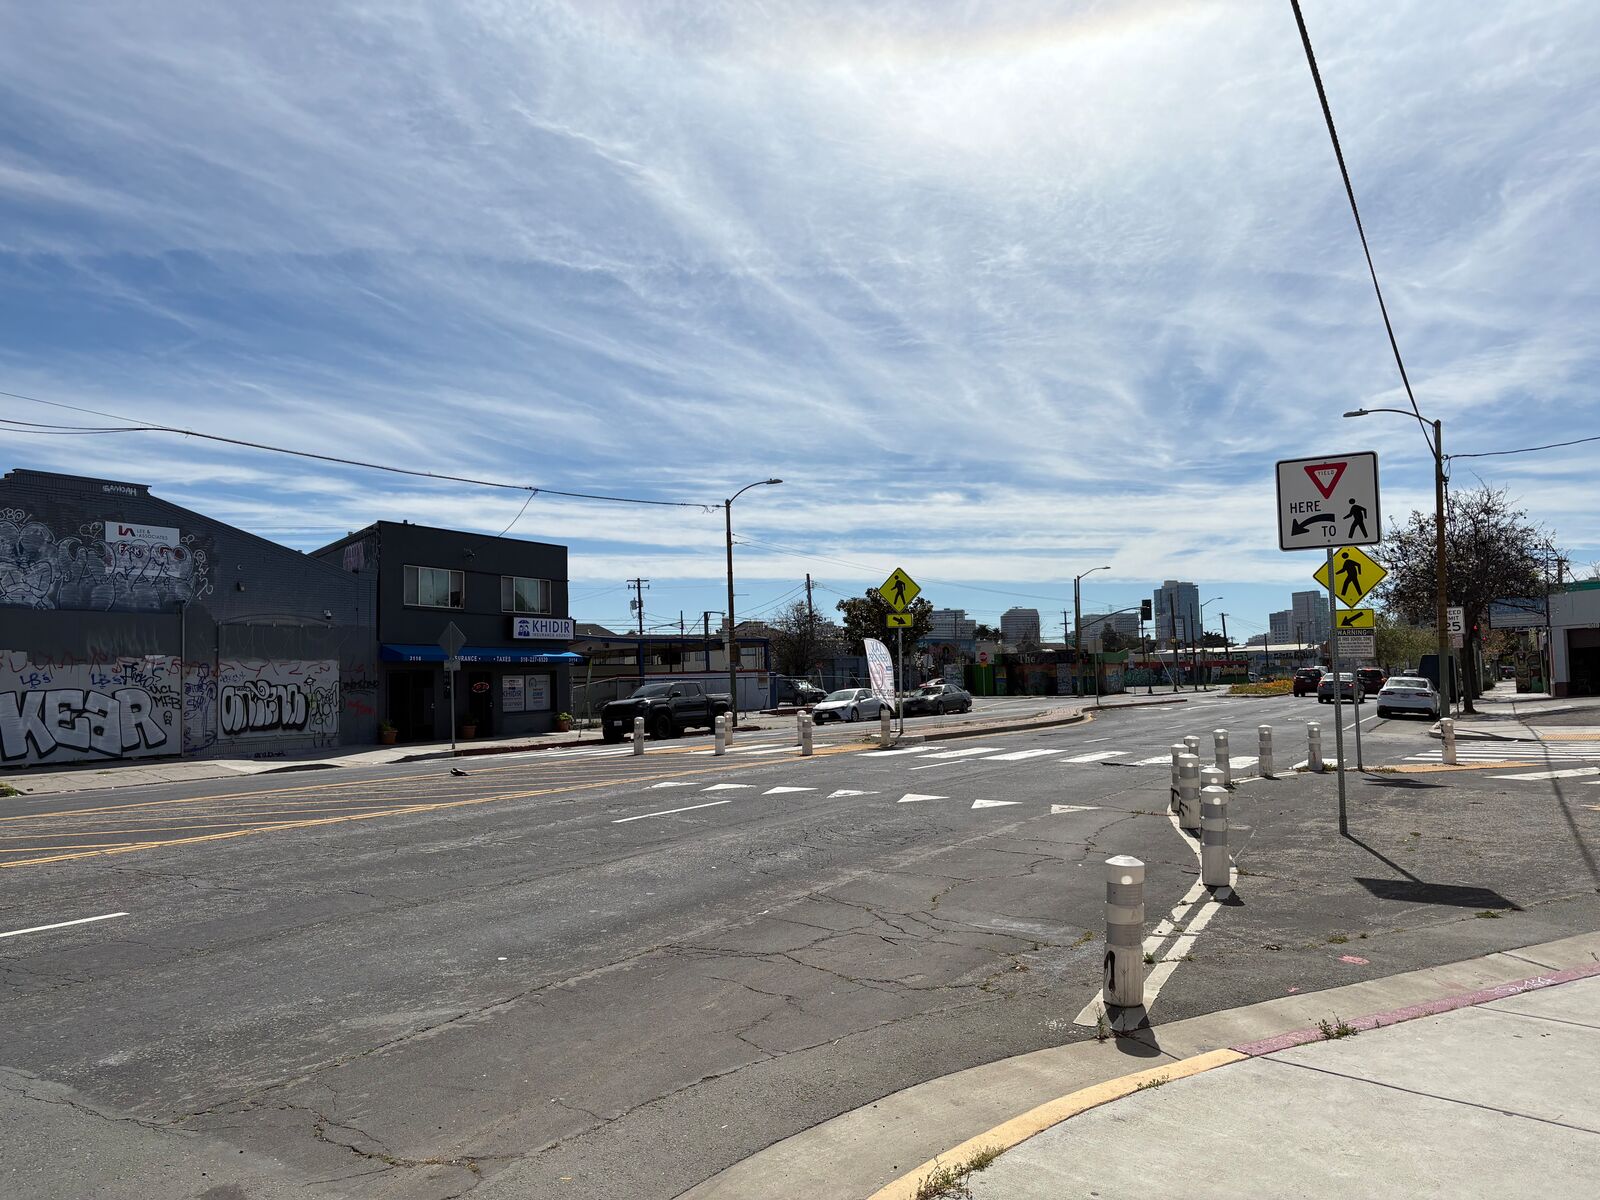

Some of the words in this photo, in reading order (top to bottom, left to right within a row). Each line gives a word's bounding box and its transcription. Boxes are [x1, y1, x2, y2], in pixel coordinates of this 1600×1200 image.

[1290, 500, 1321, 514] HERE
[1321, 525, 1336, 537] TO
[532, 620, 570, 633] KHIDIR
